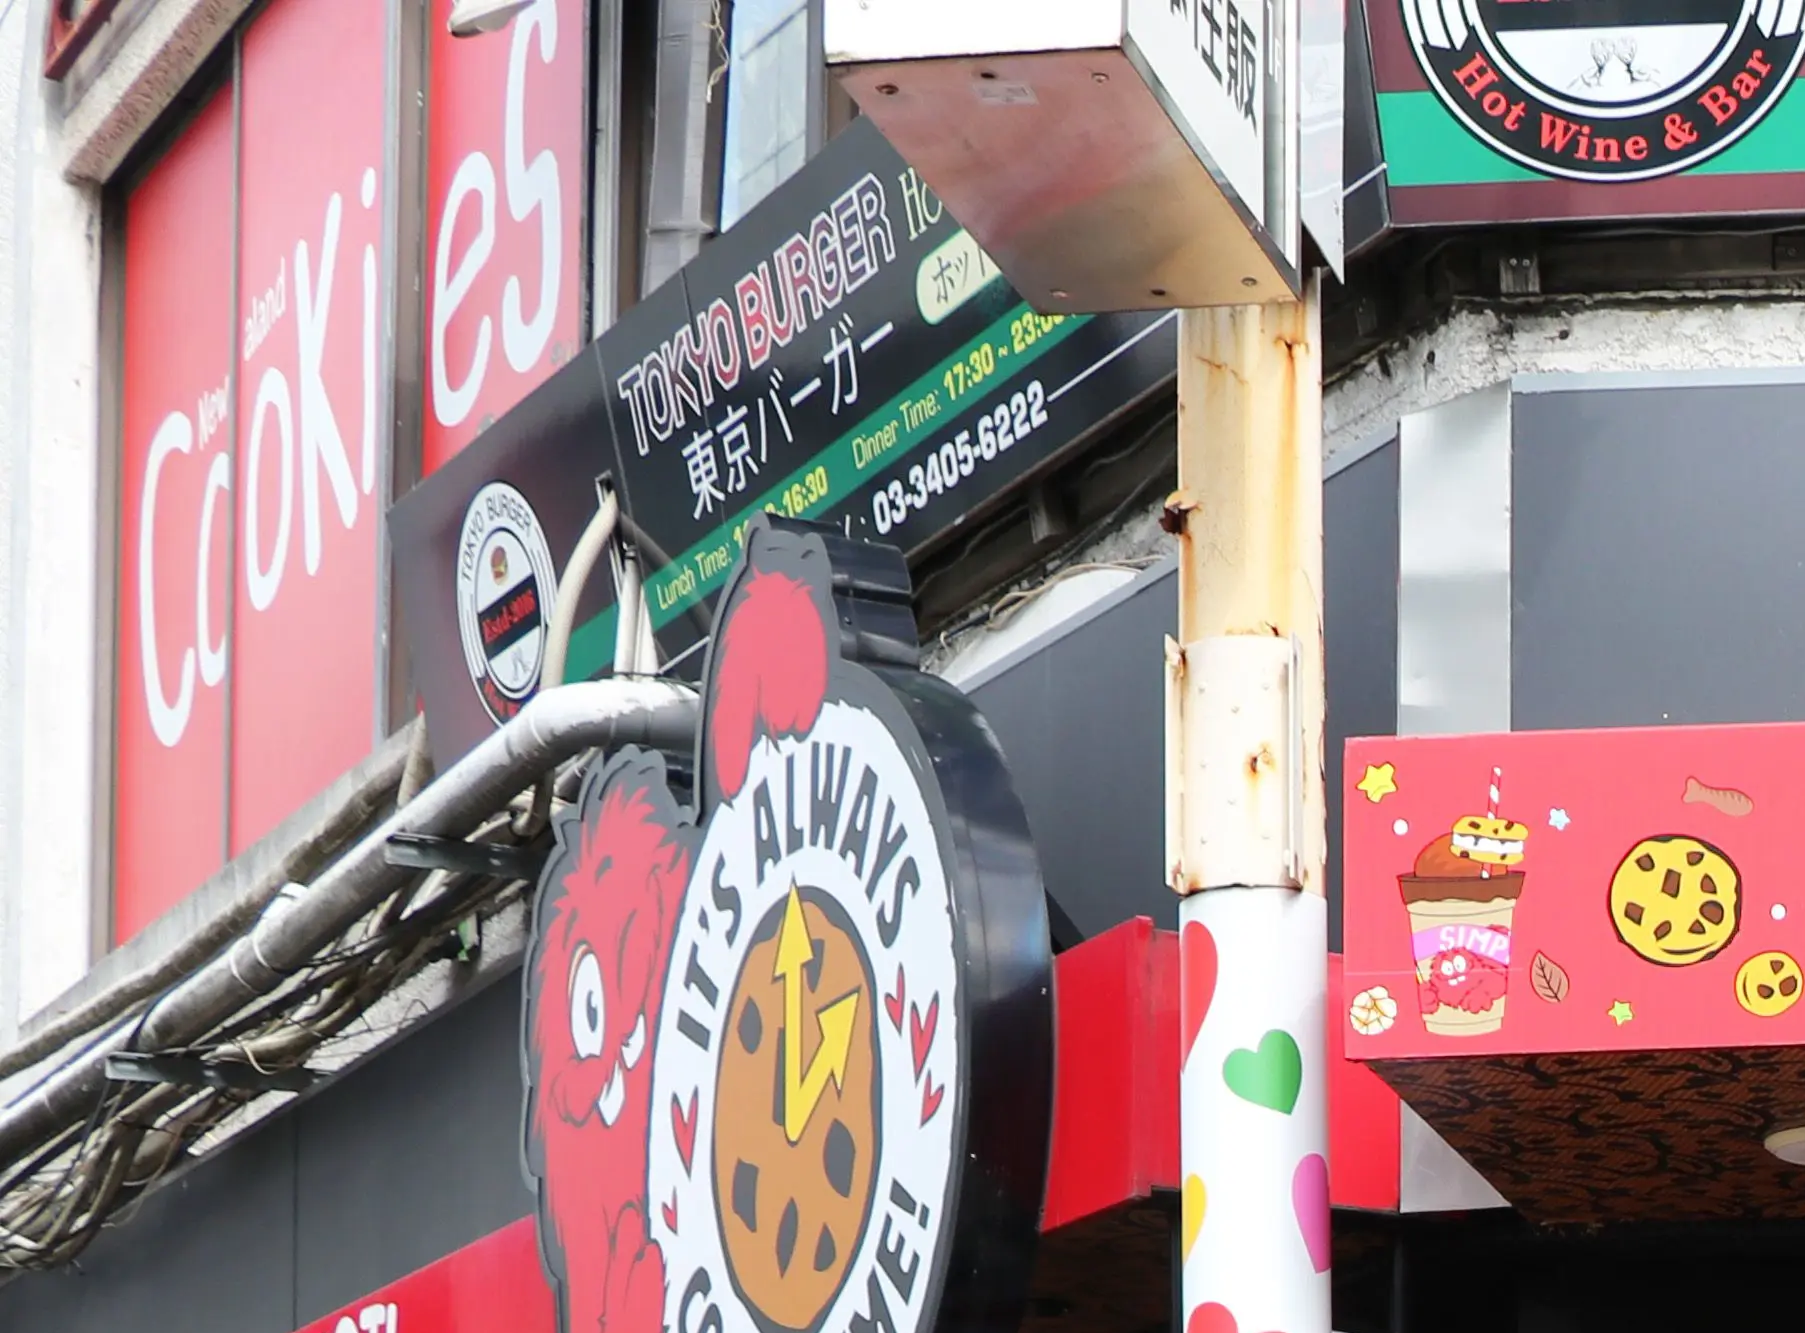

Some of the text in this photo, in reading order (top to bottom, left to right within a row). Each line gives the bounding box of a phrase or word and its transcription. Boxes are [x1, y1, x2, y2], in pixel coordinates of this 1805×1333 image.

[1453, 48, 1773, 163] Hot Wine & Bar
[617, 297, 741, 456] TOKYO
[735, 172, 897, 370] BURGER
[681, 313, 894, 519] 東京バーガー
[461, 493, 532, 583] TOKYO BURGER
[656, 564, 697, 611] Lunch
[694, 542, 733, 582] Time:
[852, 422, 898, 469] Dinner
[899, 390, 943, 431] Time:
[943, 343, 994, 400] 17:30
[872, 379, 1049, 535] 03-3405-6222
[675, 740, 921, 1053] IT'S ALWAYS
